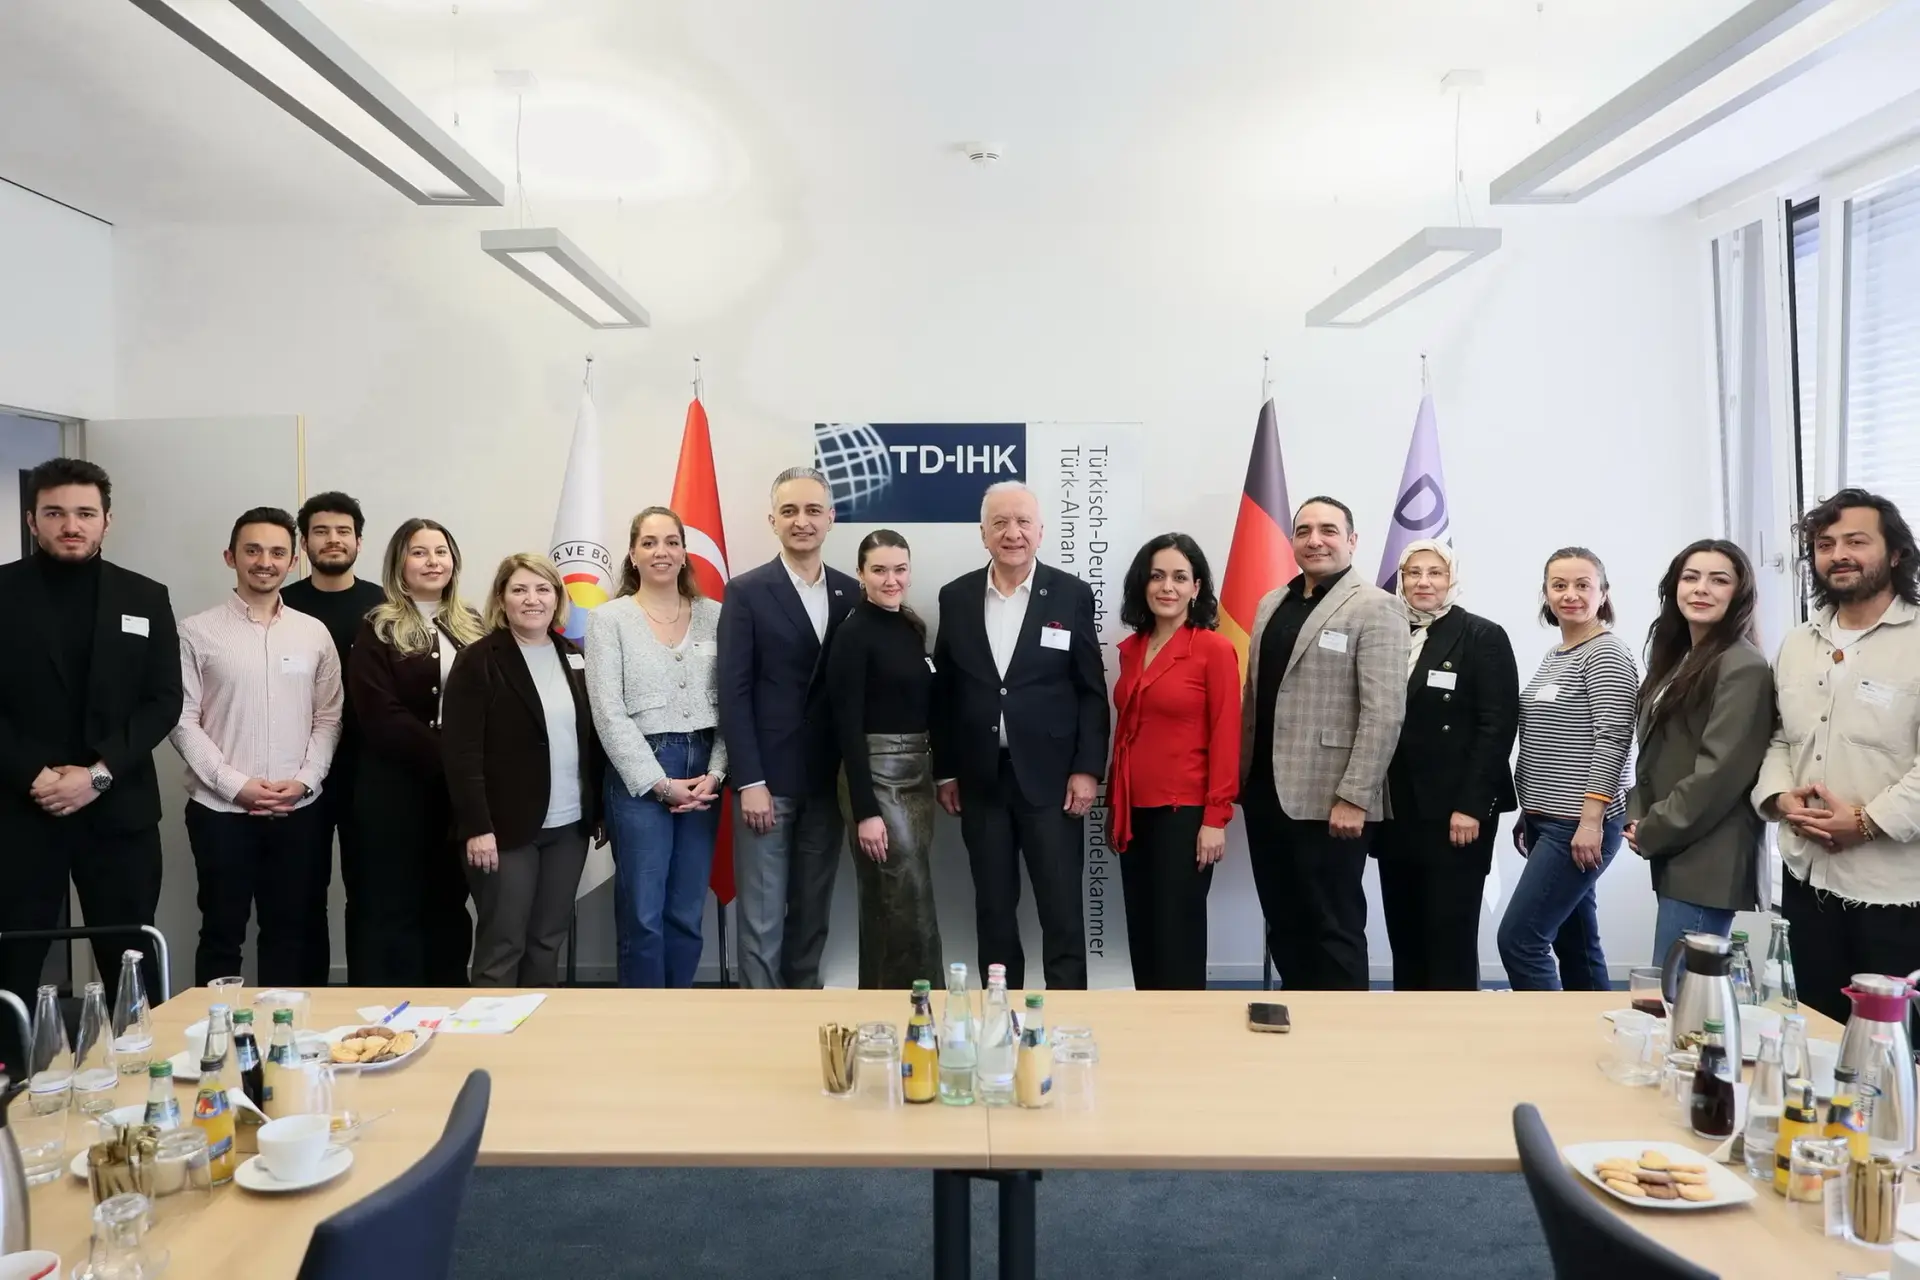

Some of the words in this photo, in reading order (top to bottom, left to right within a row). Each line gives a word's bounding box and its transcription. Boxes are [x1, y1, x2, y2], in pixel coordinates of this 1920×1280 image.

[889, 445, 1018, 474] TD-IHK
[1060, 445, 1080, 565] Türk-Alman
[1088, 445, 1108, 634] Türkisch-Deutsche
[565, 546, 585, 556] VE
